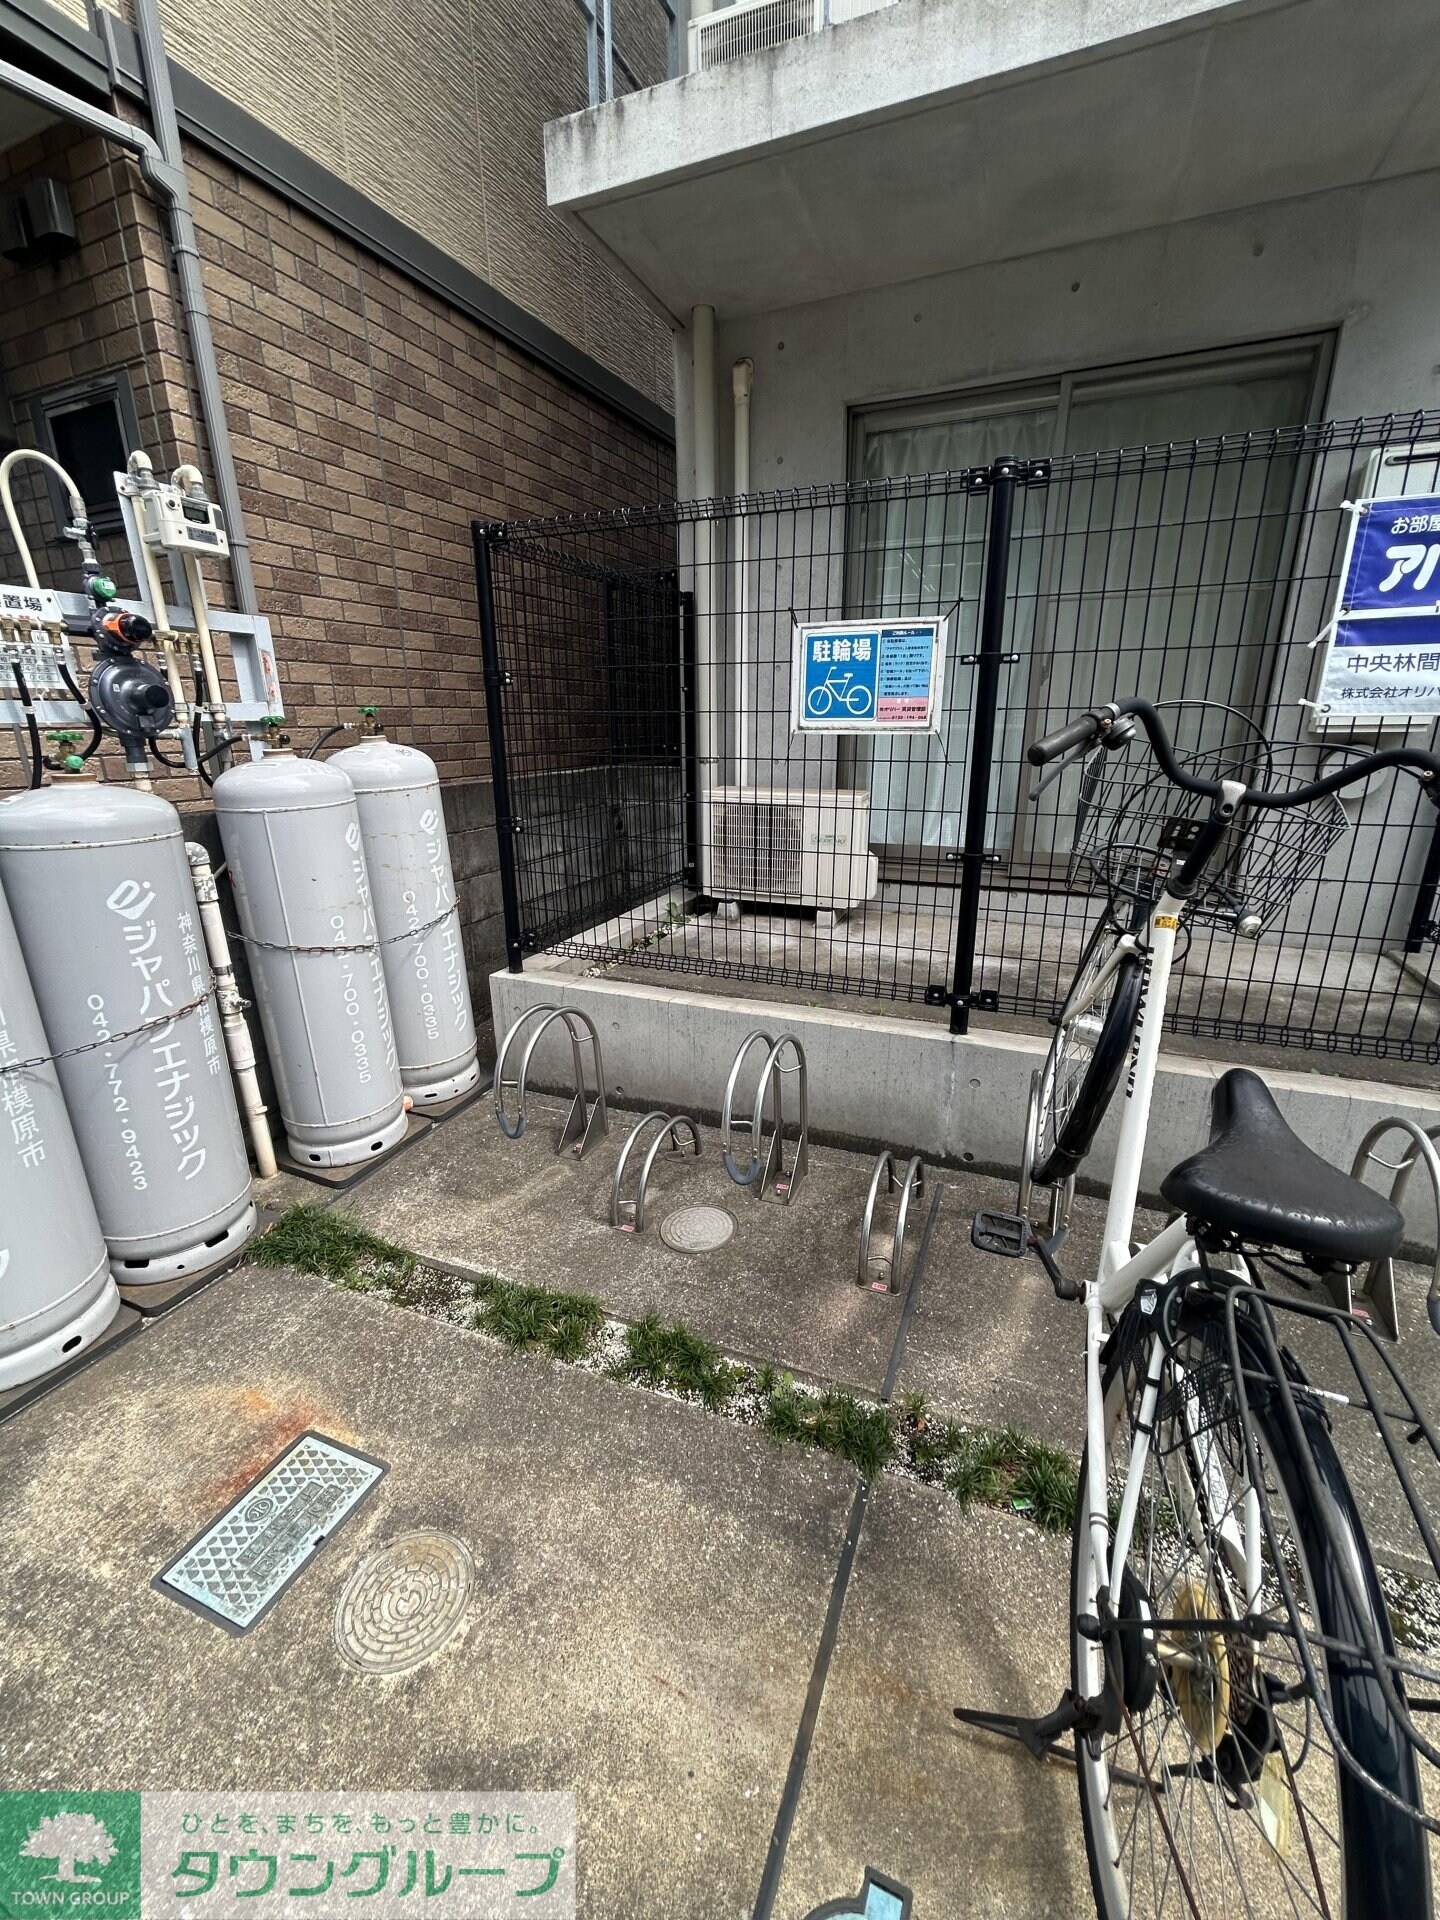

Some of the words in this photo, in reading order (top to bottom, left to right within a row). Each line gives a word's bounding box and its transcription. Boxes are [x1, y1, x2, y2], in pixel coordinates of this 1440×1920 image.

[813, 638, 872, 663] 駐輪場
[1347, 652, 1440, 674] 中央林間
